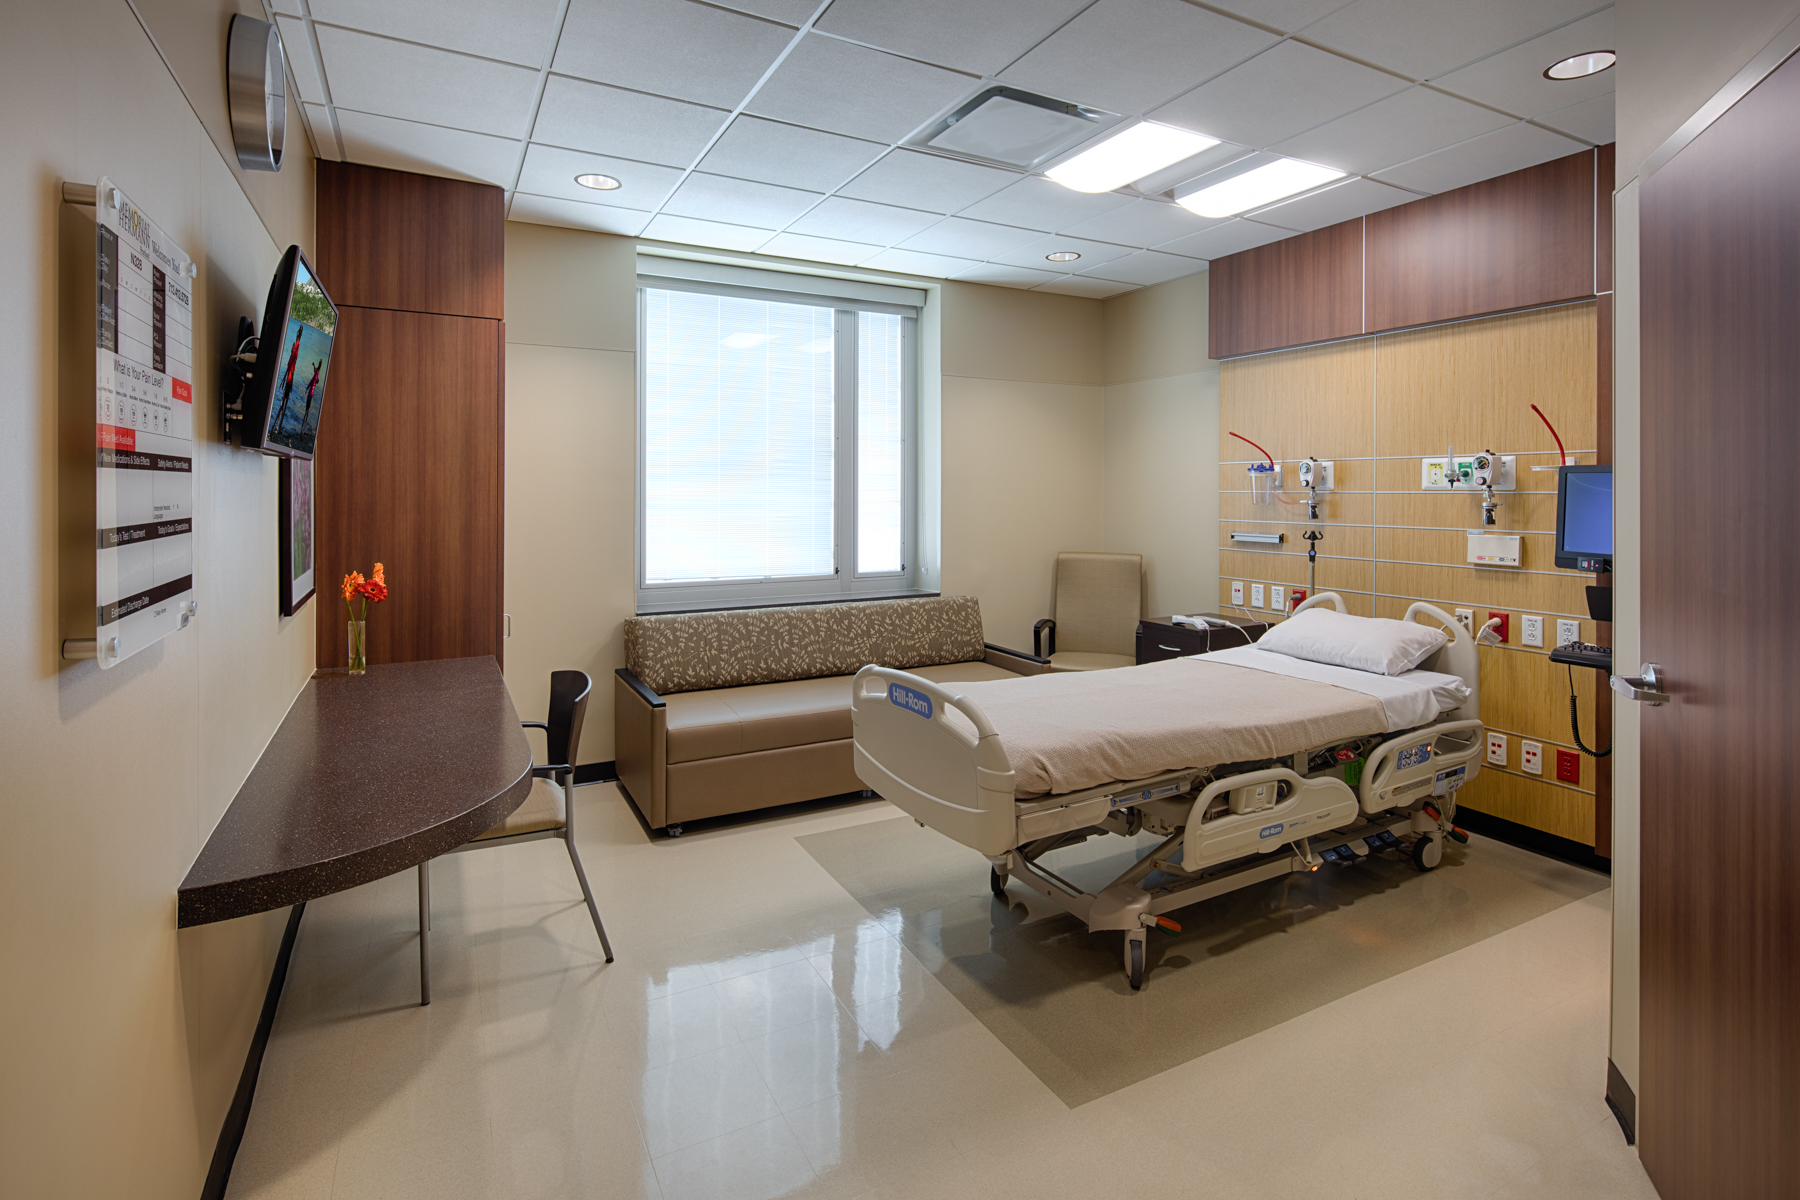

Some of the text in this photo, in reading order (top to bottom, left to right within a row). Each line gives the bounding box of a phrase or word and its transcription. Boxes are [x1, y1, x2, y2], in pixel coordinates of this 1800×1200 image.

[119, 200, 150, 238] MEMORIAL
[119, 212, 150, 250] HERMANN
[152, 240, 171, 268] Welcomes
[114, 359, 164, 389] What is Your Pain Level?
[109, 533, 122, 544] Today's
[111, 596, 150, 618] Estimated Discharge Date
[892, 686, 929, 714] Hill-Rom
[1261, 826, 1282, 837] Hill-Rom
